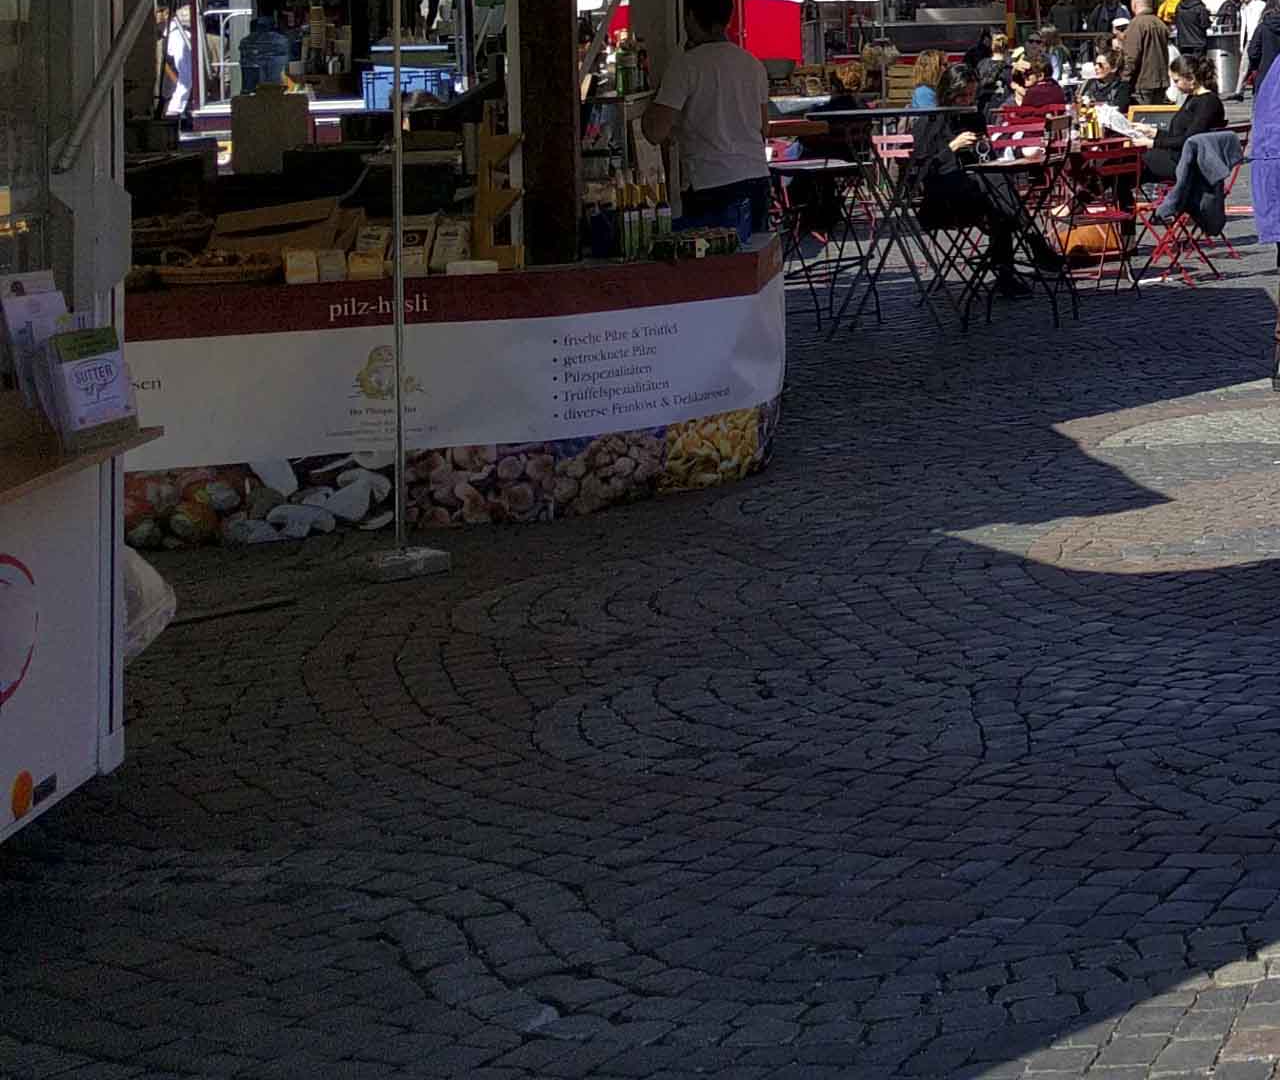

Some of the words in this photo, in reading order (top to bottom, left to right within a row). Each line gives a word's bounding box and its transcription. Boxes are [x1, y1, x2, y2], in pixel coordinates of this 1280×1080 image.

[329, 293, 429, 321] pilz-hsli
[604, 327, 628, 341] Pilze
[632, 327, 640, 338] &
[563, 348, 630, 367] getrocknete
[632, 344, 657, 357] Pilze
[75, 364, 113, 385] SUTTER
[563, 407, 608, 421] diverse
